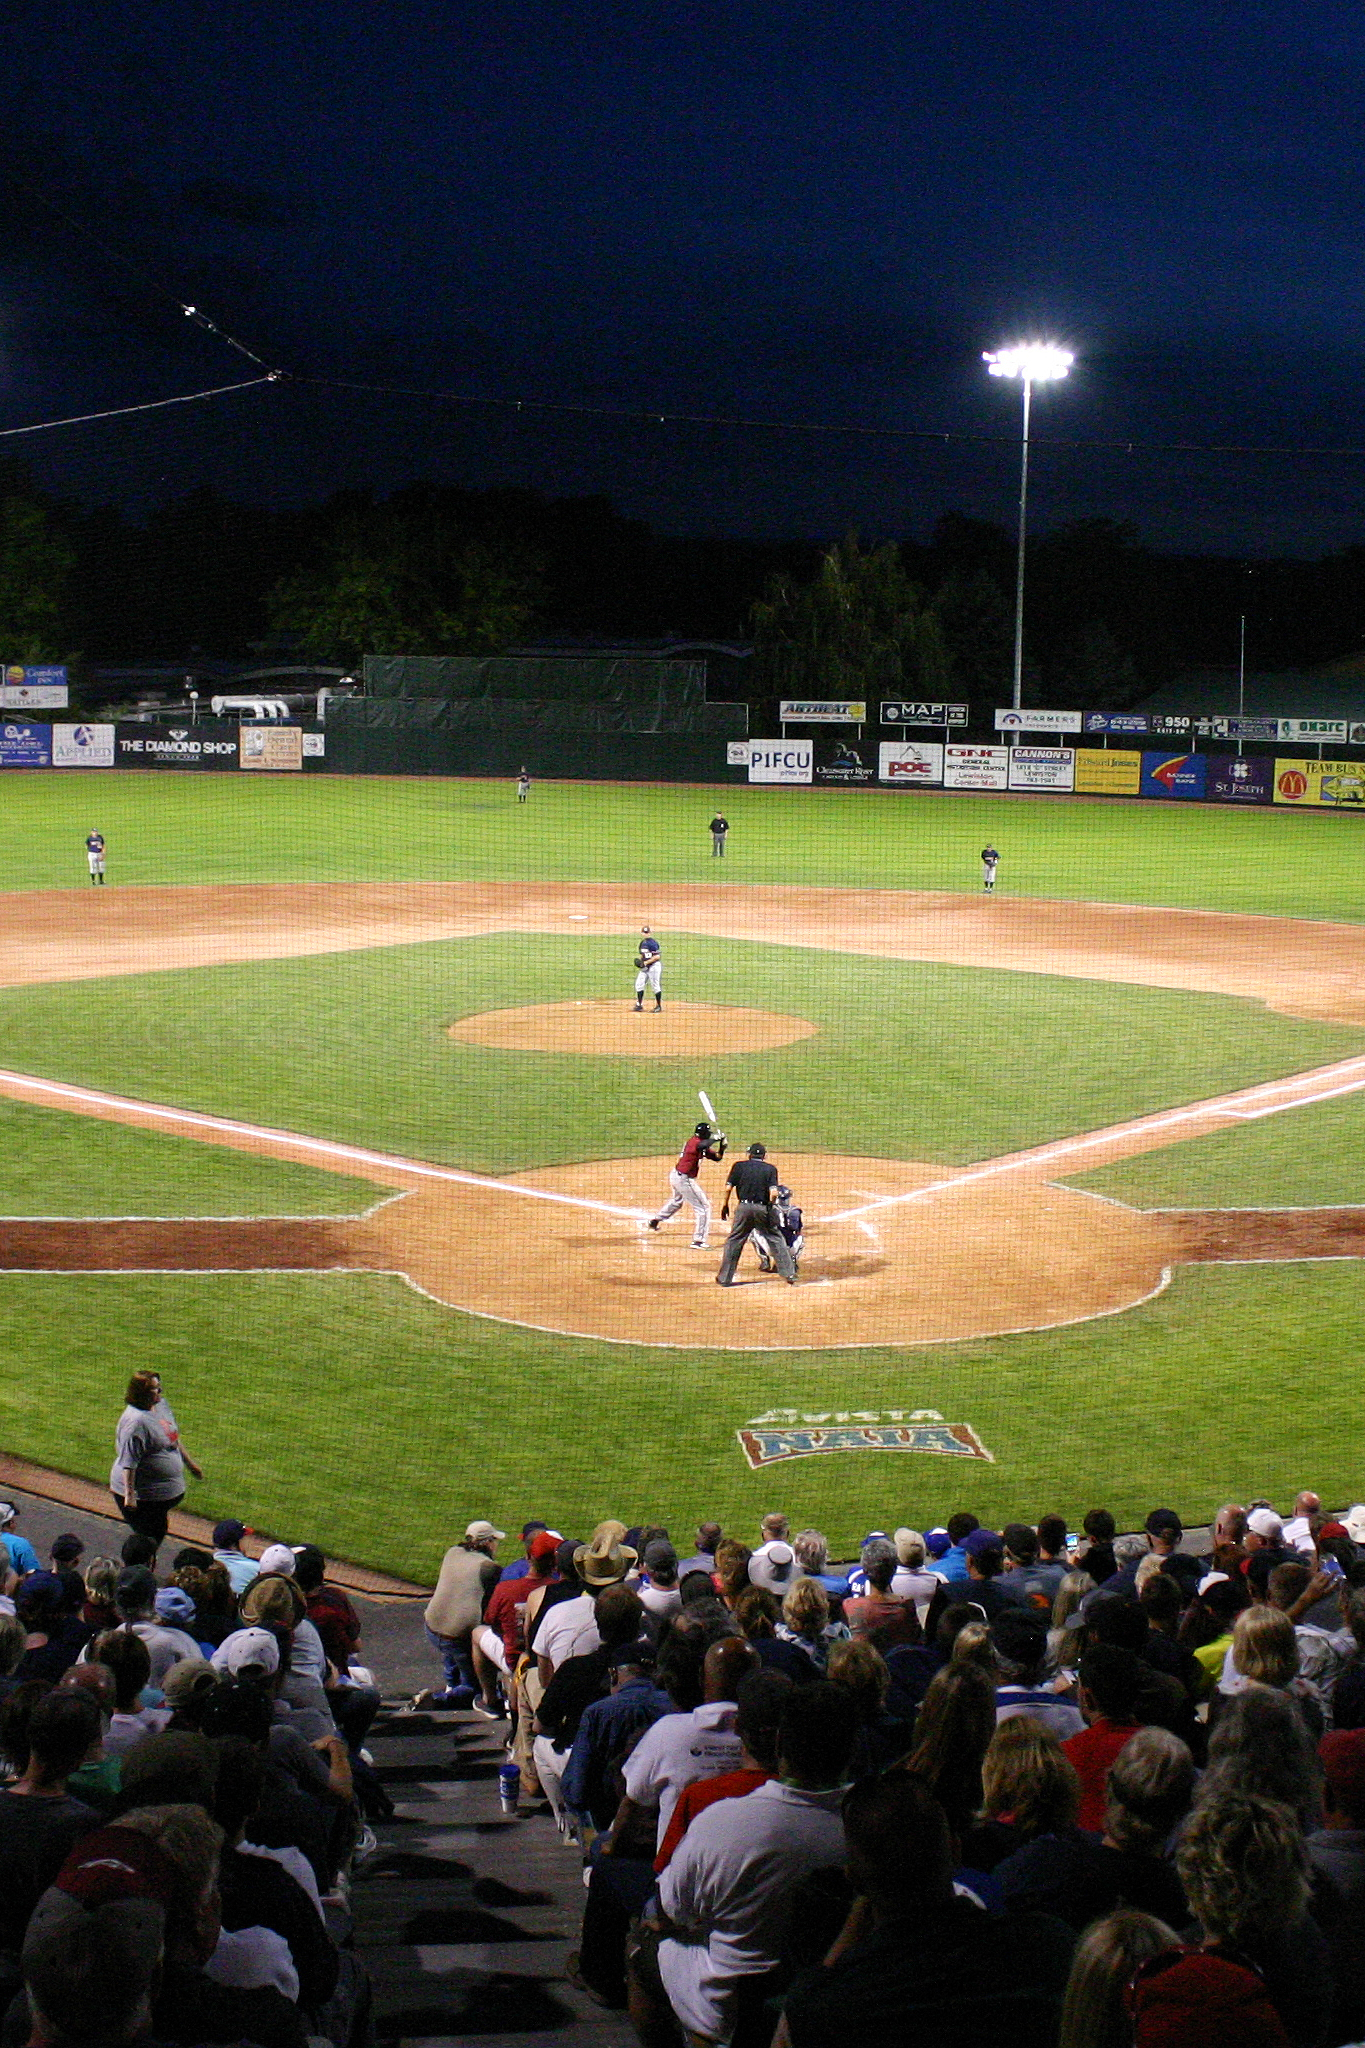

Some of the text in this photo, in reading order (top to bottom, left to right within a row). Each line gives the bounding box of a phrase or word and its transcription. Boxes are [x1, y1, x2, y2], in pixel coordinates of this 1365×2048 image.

[901, 704, 943, 715] MAP
[1026, 715, 1078, 724] FARMERS
[1165, 717, 1190, 727] 950
[56, 746, 112, 757] APPLIED
[120, 740, 237, 755] THE DIAMOND SHOP
[1014, 750, 1070, 760] CANNON'S
[1306, 761, 1333, 773] TEAM
[752, 1427, 977, 1460] NAIA
